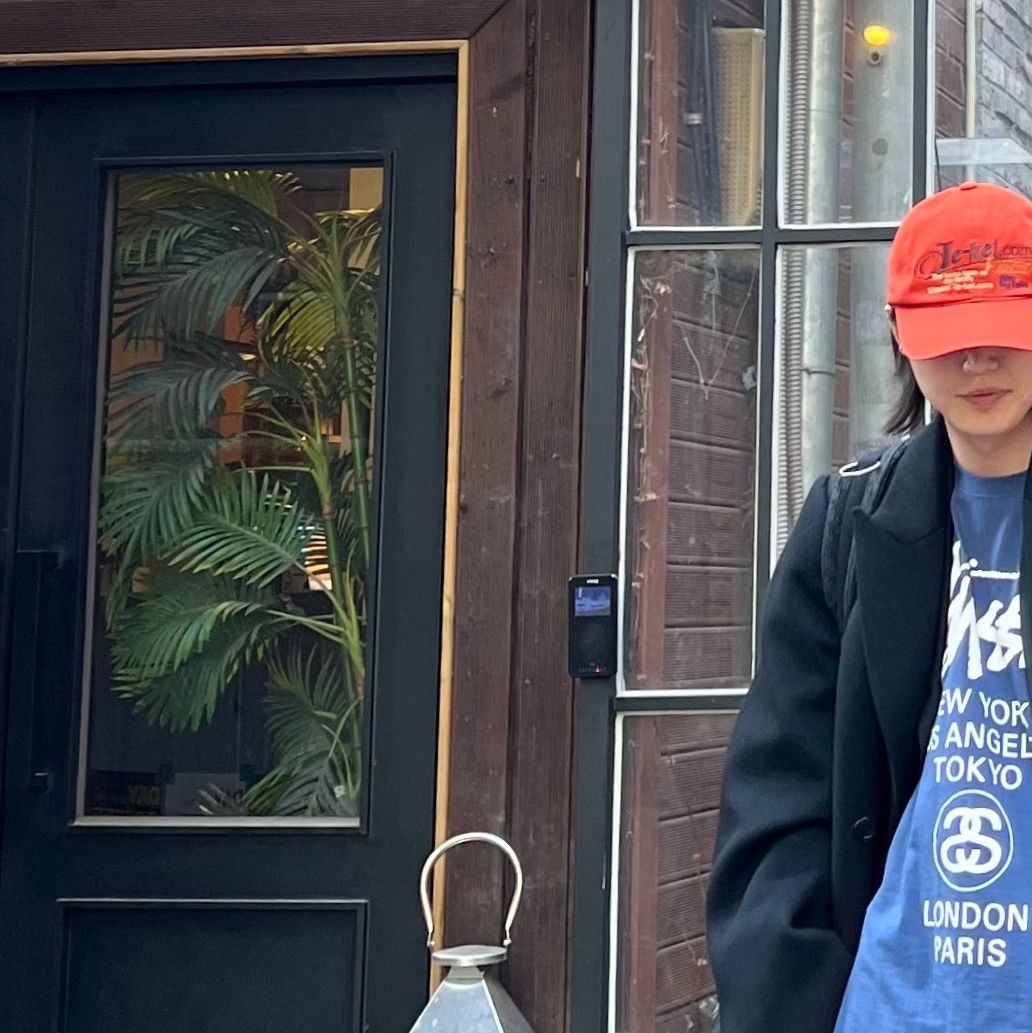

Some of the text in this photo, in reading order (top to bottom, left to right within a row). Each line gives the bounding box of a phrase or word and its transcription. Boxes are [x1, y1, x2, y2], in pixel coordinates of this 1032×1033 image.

[933, 755, 1023, 791] TOKYO
[923, 899, 1029, 932] LONDON
[934, 936, 1008, 968] PARIS
